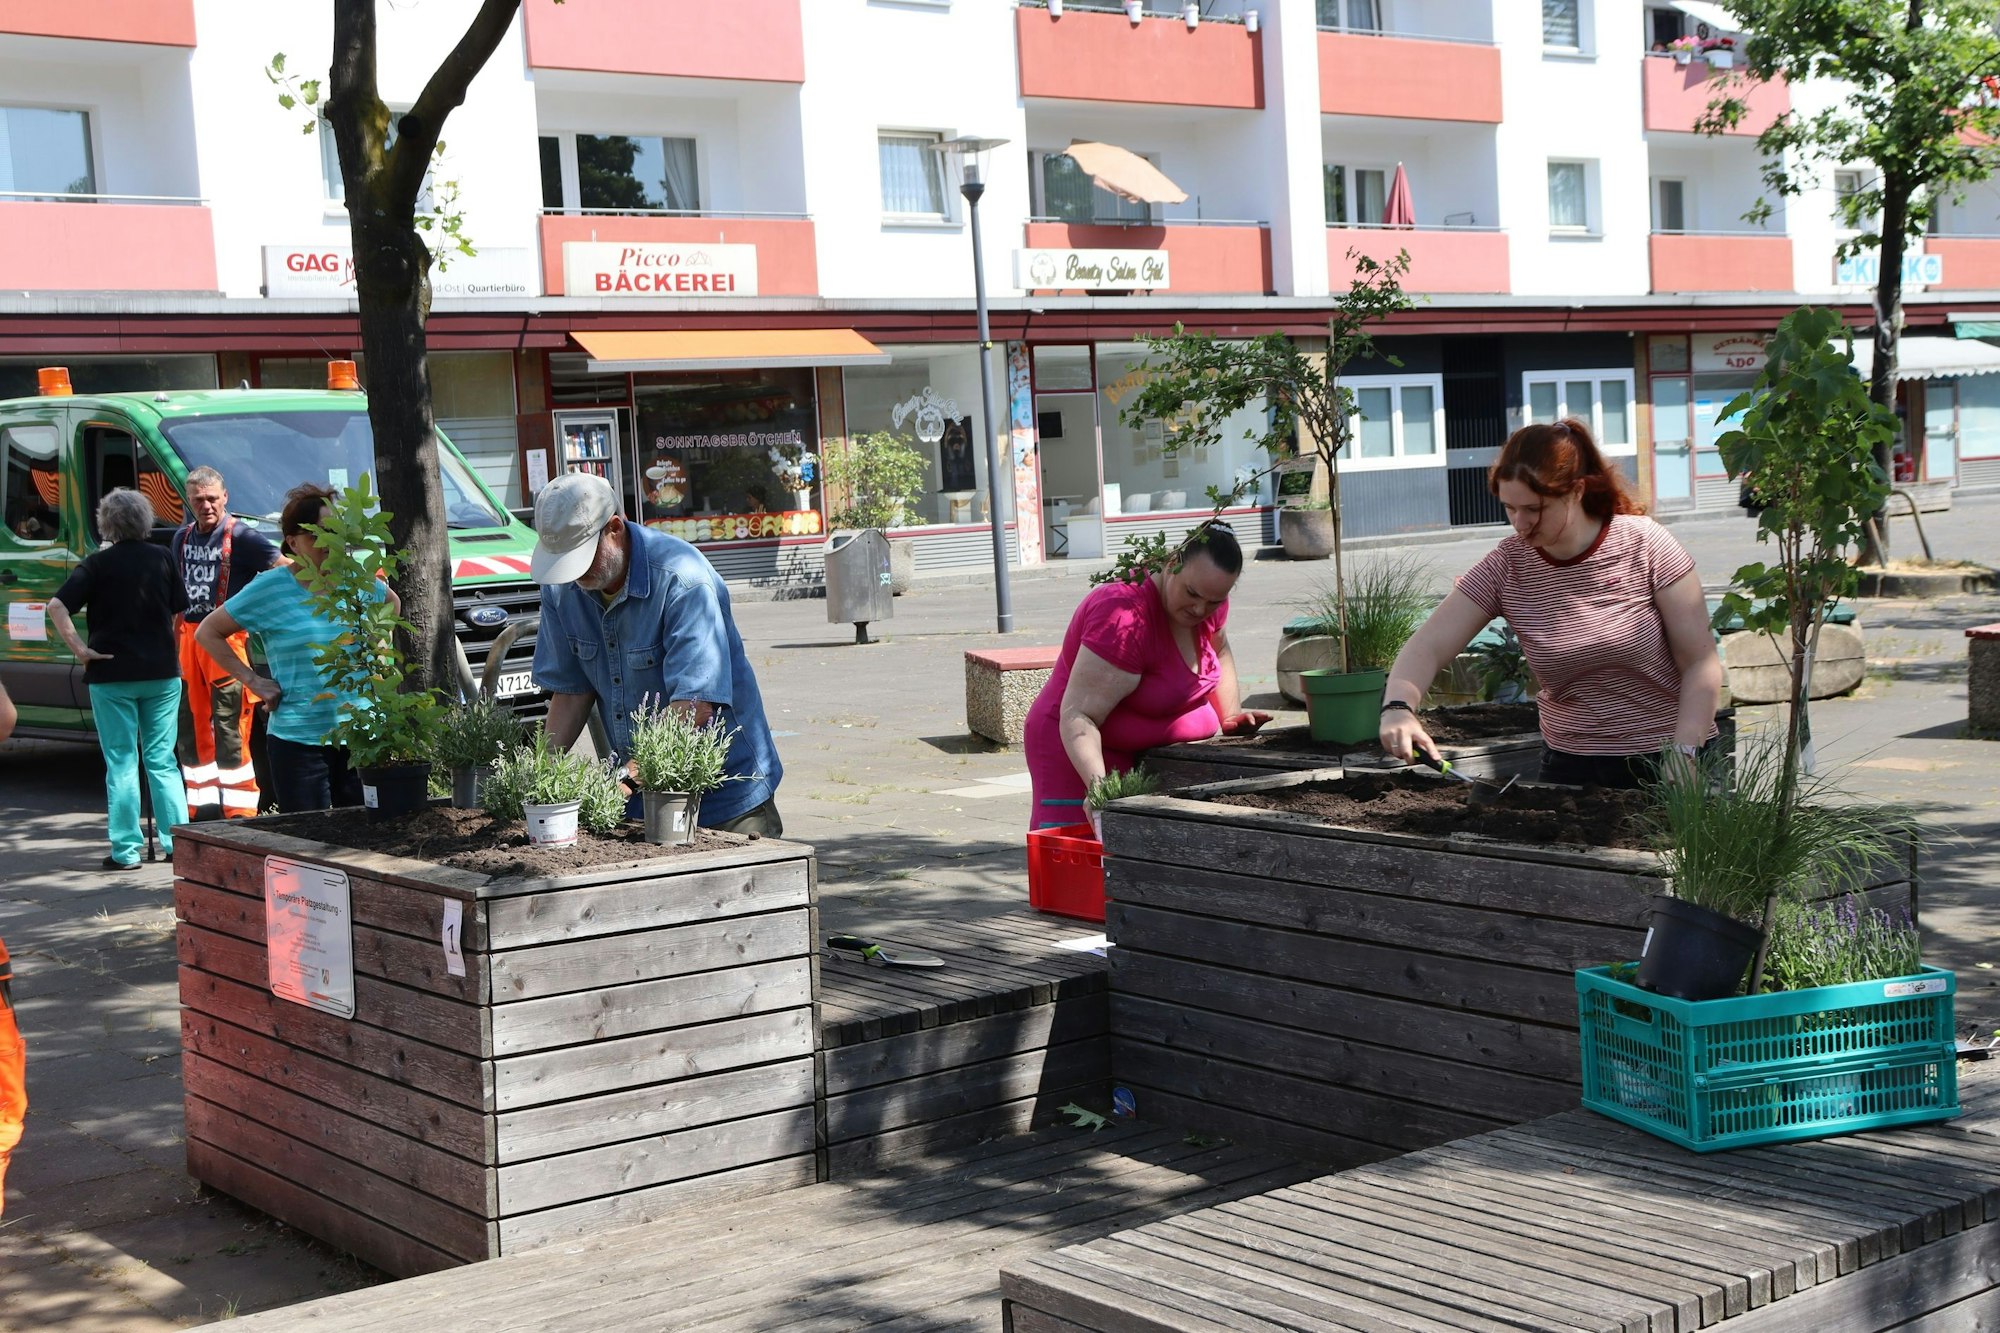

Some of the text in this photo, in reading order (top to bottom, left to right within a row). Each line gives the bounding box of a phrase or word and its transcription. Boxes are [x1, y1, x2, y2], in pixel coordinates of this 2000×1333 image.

[286, 253, 339, 272] GAG
[618, 247, 681, 267] Picco
[1066, 253, 1103, 287] Beauty
[1107, 256, 1137, 283] Salon
[1855, 256, 1922, 282] KIK
[467, 283, 526, 294] Quartierbüro
[595, 269, 736, 292] BÄCKEREI
[1726, 357, 1756, 368] ADO
[656, 431, 801, 449] SONNTAGSBRÖTCHEN
[183, 544, 222, 560] THANK
[185, 563, 216, 583] YOU
[447, 923, 459, 955] 1
